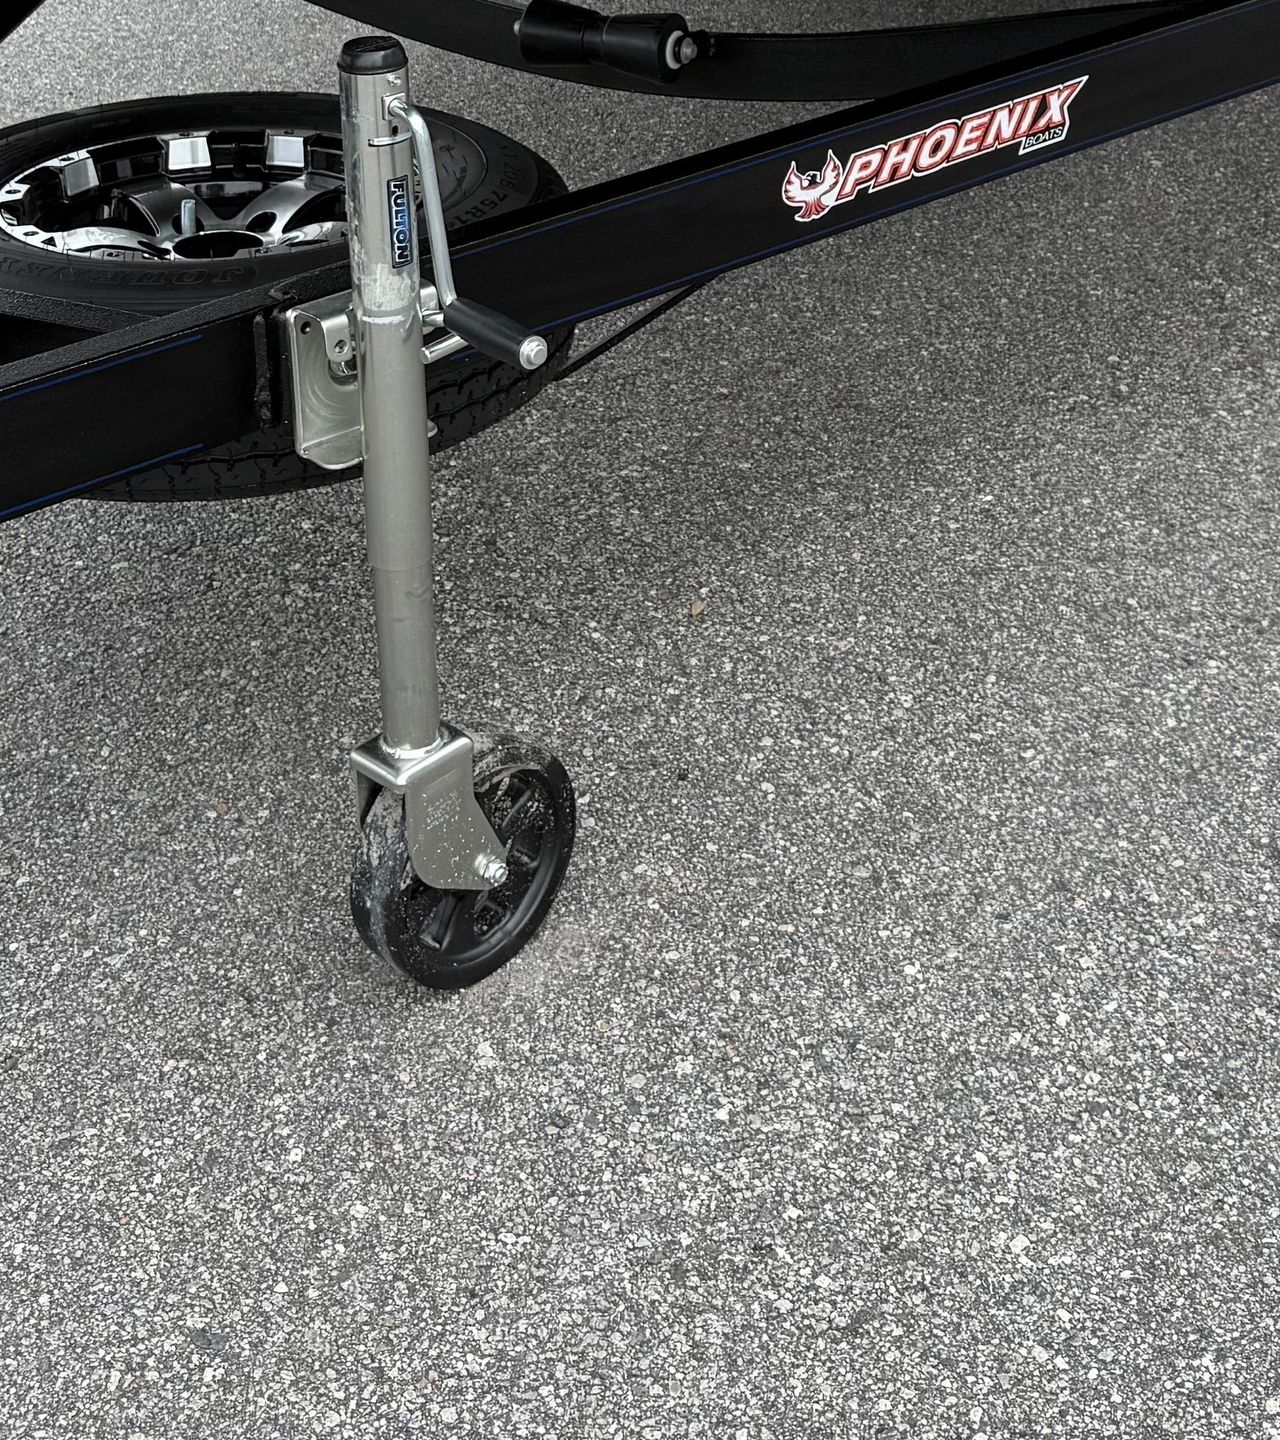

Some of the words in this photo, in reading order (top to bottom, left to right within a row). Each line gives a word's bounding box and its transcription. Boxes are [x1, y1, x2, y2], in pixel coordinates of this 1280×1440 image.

[834, 79, 1086, 202] PHOENIX
[1024, 127, 1064, 148] BOATS
[388, 180, 412, 265] FULTON
